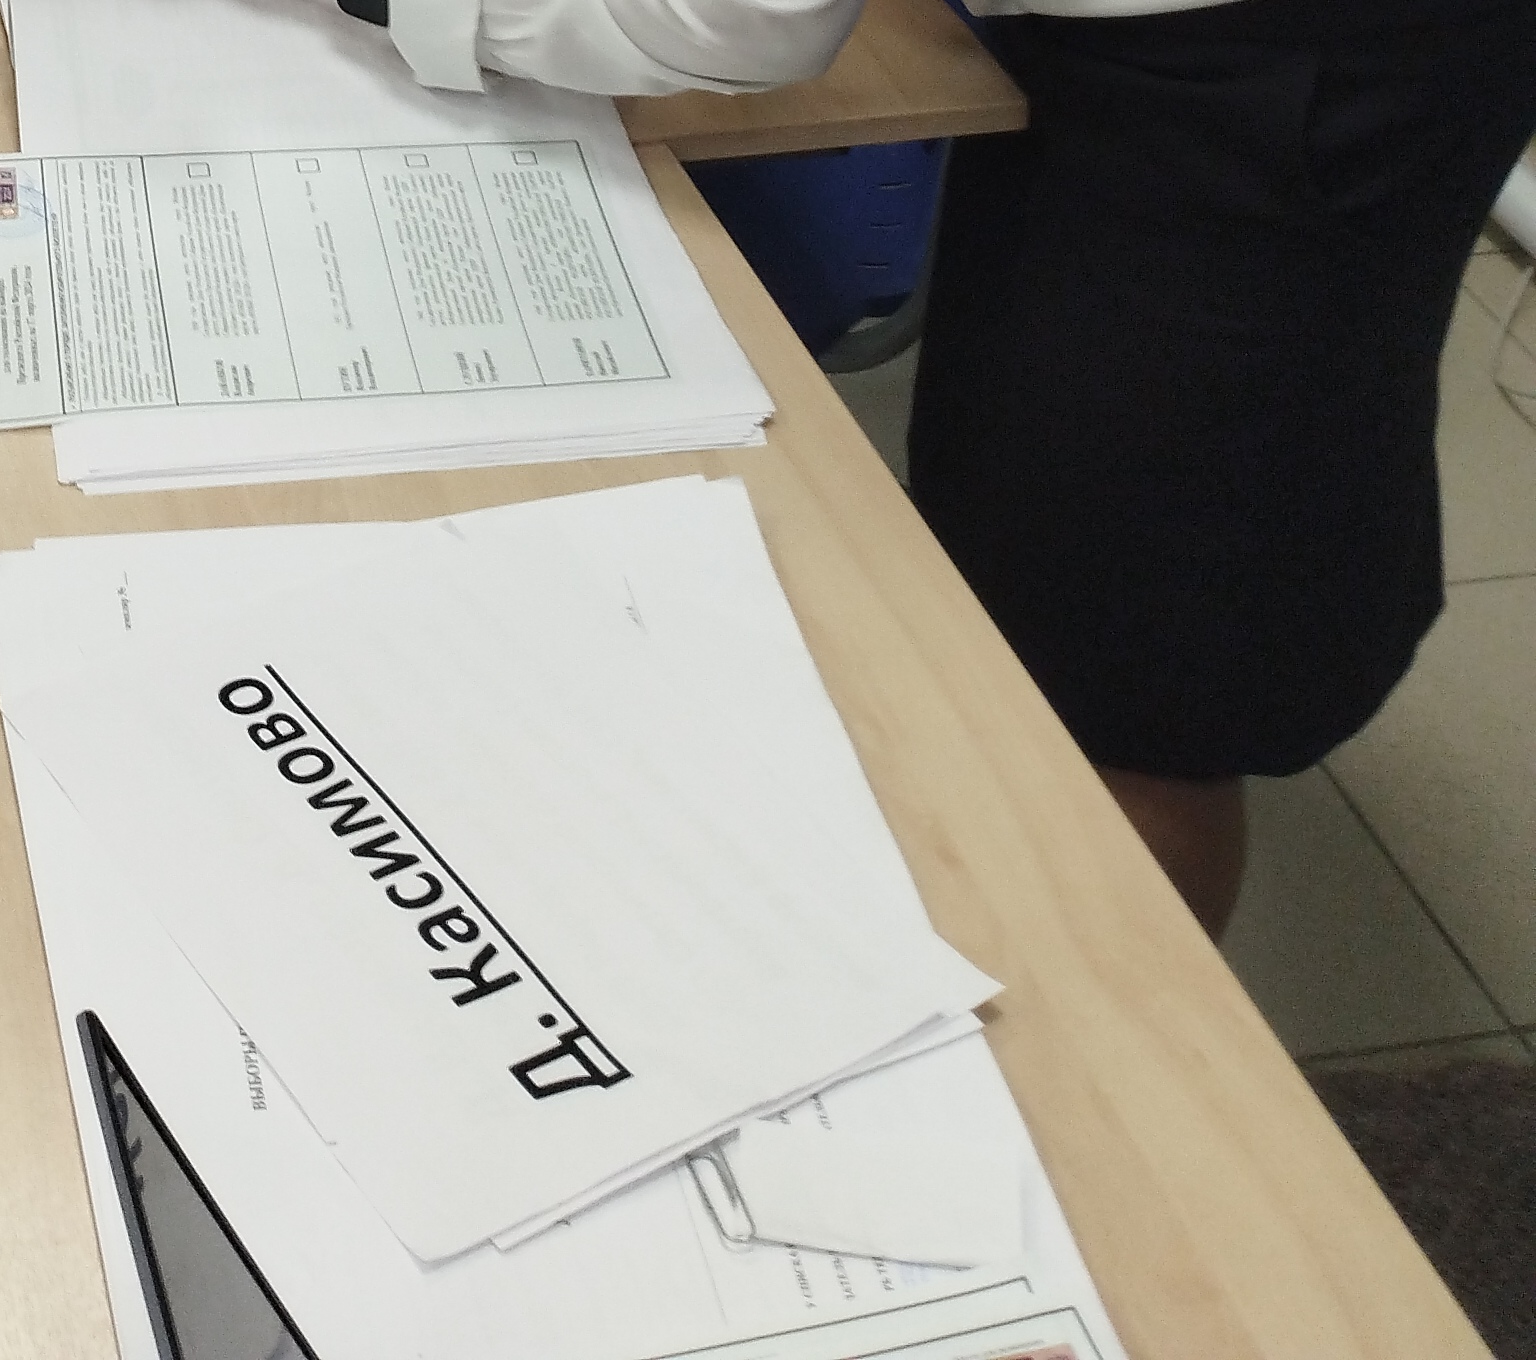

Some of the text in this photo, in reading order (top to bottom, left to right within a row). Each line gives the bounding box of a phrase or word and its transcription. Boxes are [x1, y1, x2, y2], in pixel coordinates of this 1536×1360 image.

[217, 677, 633, 1100] Д. Касимово
[240, 1041, 268, 1111] ВЫБОРЫ
